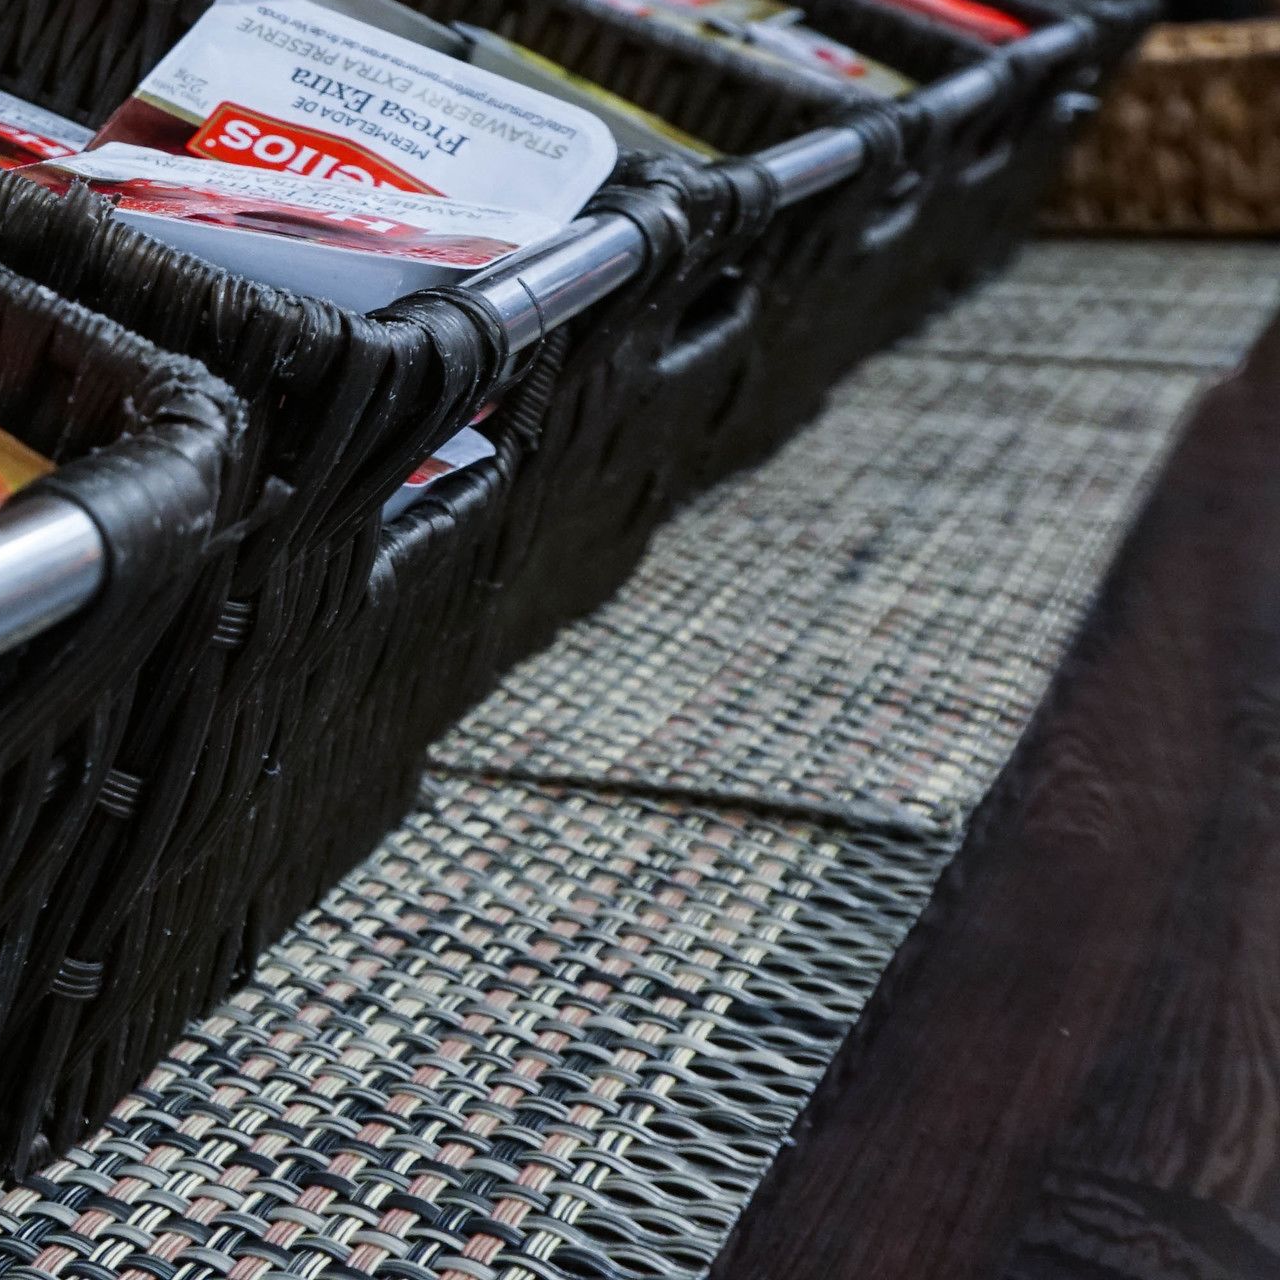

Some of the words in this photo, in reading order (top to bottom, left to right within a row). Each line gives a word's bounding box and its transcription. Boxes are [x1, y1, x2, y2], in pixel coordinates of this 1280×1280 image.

[236, 16, 340, 66] PRESERVE
[290, 67, 375, 114] Extra
[343, 56, 414, 94] EXTRA
[291, 95, 318, 114] DE
[381, 98, 471, 157] Fresa
[412, 87, 569, 160] STRAWBERRY
[219, 120, 401, 192] elios
[321, 110, 430, 160] MERMELADA
